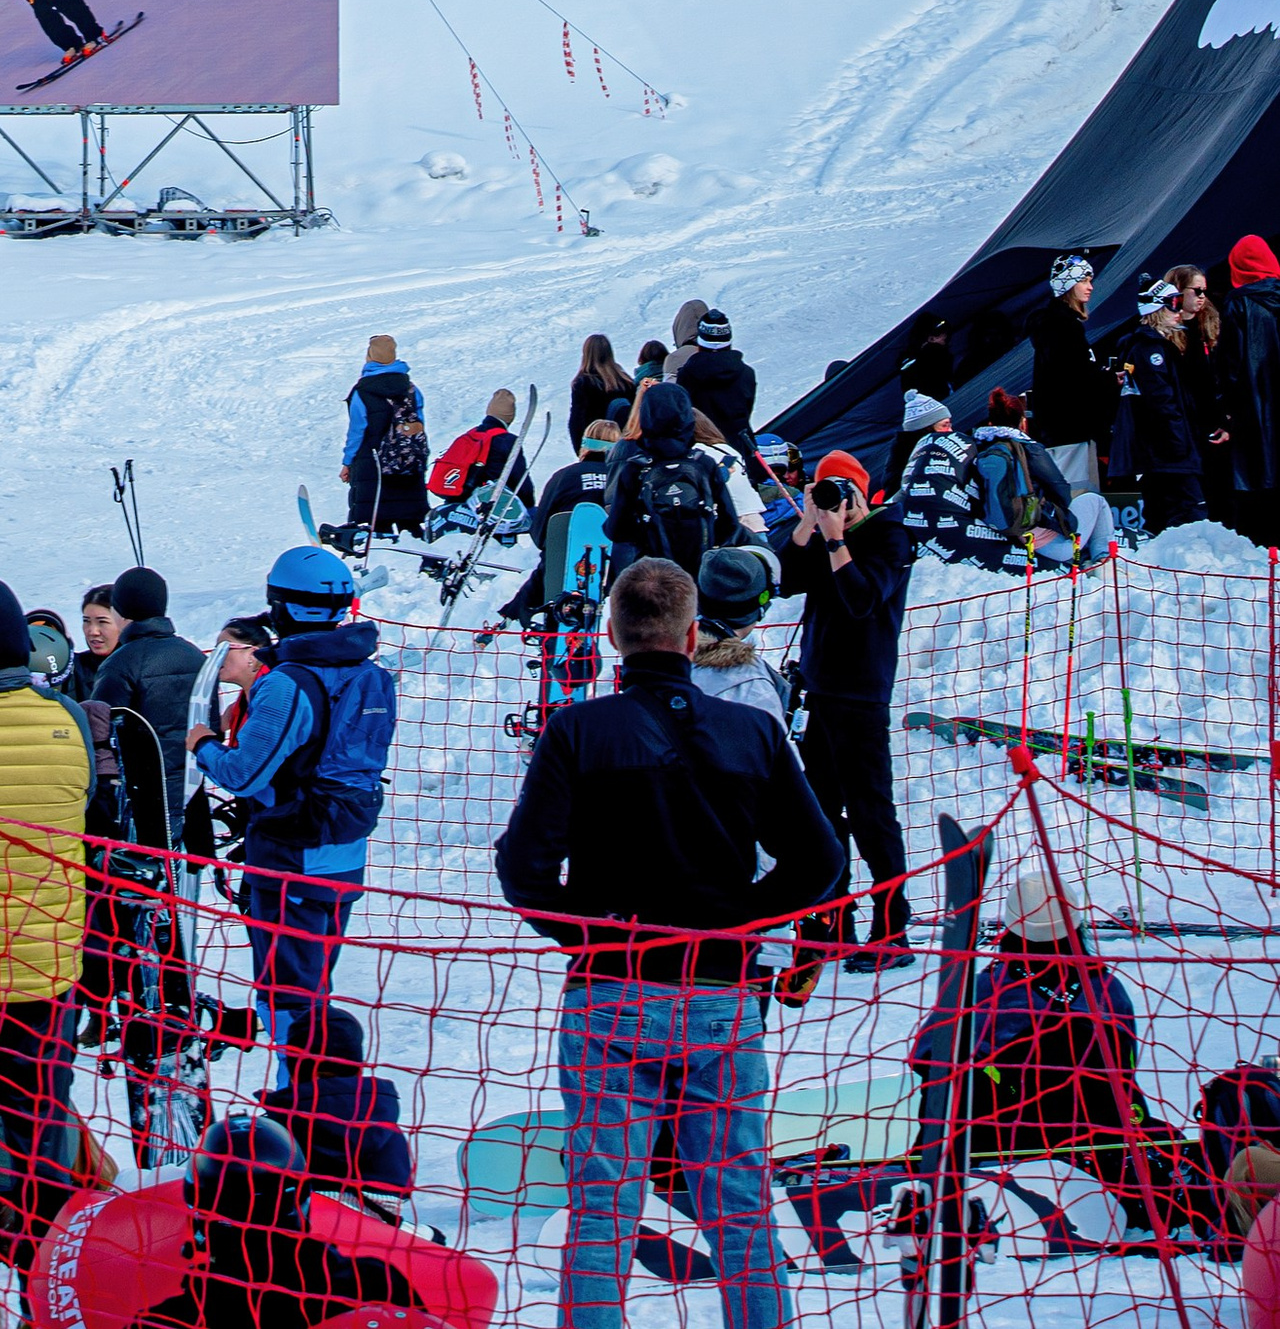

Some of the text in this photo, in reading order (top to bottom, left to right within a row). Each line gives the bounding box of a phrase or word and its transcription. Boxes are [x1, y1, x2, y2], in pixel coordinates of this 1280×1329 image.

[934, 436, 968, 462] GORILLA
[924, 465, 956, 476] GORILLA
[910, 488, 936, 496] GORILLA
[942, 490, 971, 511] GORILLA
